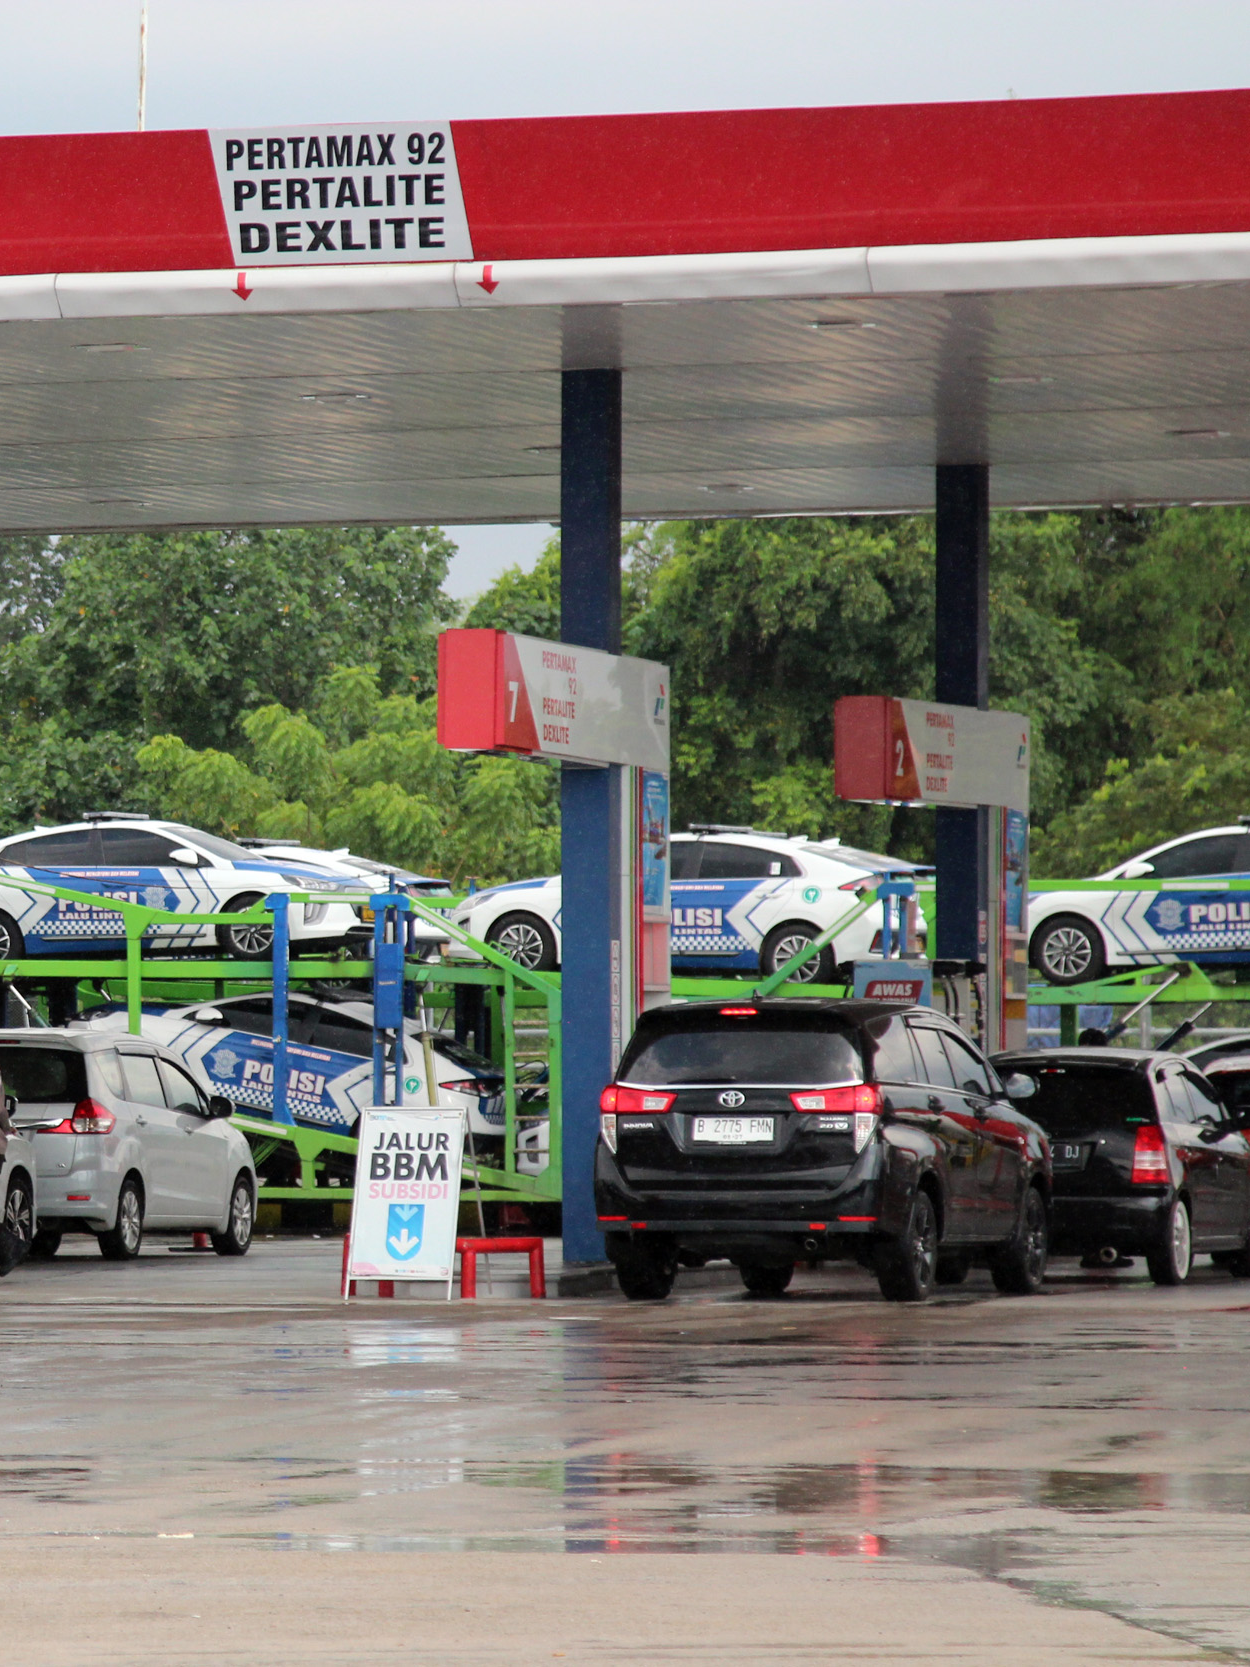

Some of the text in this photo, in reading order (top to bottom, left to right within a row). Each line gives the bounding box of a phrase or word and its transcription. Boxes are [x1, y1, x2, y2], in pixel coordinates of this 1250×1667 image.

[226, 132, 446, 171] PERTAMAX 92
[233, 173, 446, 211] PERTALITE
[239, 217, 446, 254] DEXLITE
[542, 651, 577, 674] PERTAMAX
[568, 678, 577, 695] 92
[508, 681, 519, 723] 7
[542, 697, 576, 719] PERTALITE
[543, 724, 570, 744] DEXLITE
[895, 739, 904, 776] 2
[58, 912, 90, 920] LALU
[670, 908, 723, 927] LISI
[1190, 902, 1250, 923] POLI
[674, 927, 723, 935] LINTAS
[872, 984, 913, 996] AWAS
[244, 1059, 326, 1096] POISI
[697, 1119, 772, 1133] B 2775 FMN
[373, 1132, 450, 1151] JALUR
[369, 1152, 449, 1181] BBM
[368, 1182, 449, 1200] SUBSIDI
